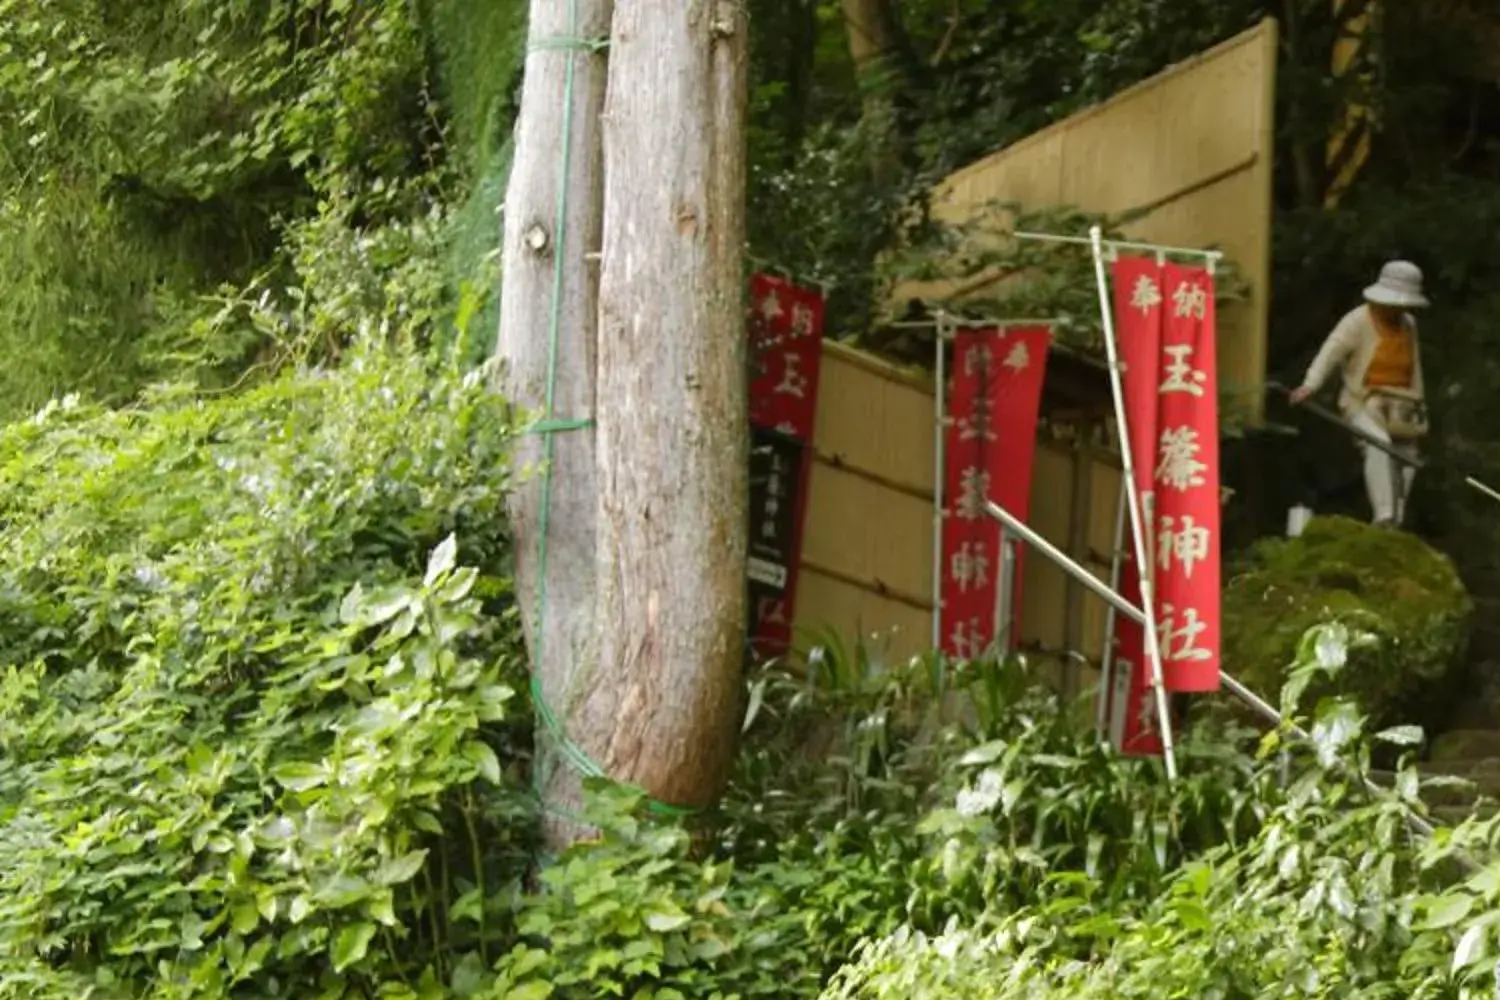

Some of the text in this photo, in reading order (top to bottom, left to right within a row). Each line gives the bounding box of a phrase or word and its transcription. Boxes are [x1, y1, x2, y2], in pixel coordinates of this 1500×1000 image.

[1130, 274, 1206, 320] 奉納
[1156, 344, 1212, 662] 玉簾神社
